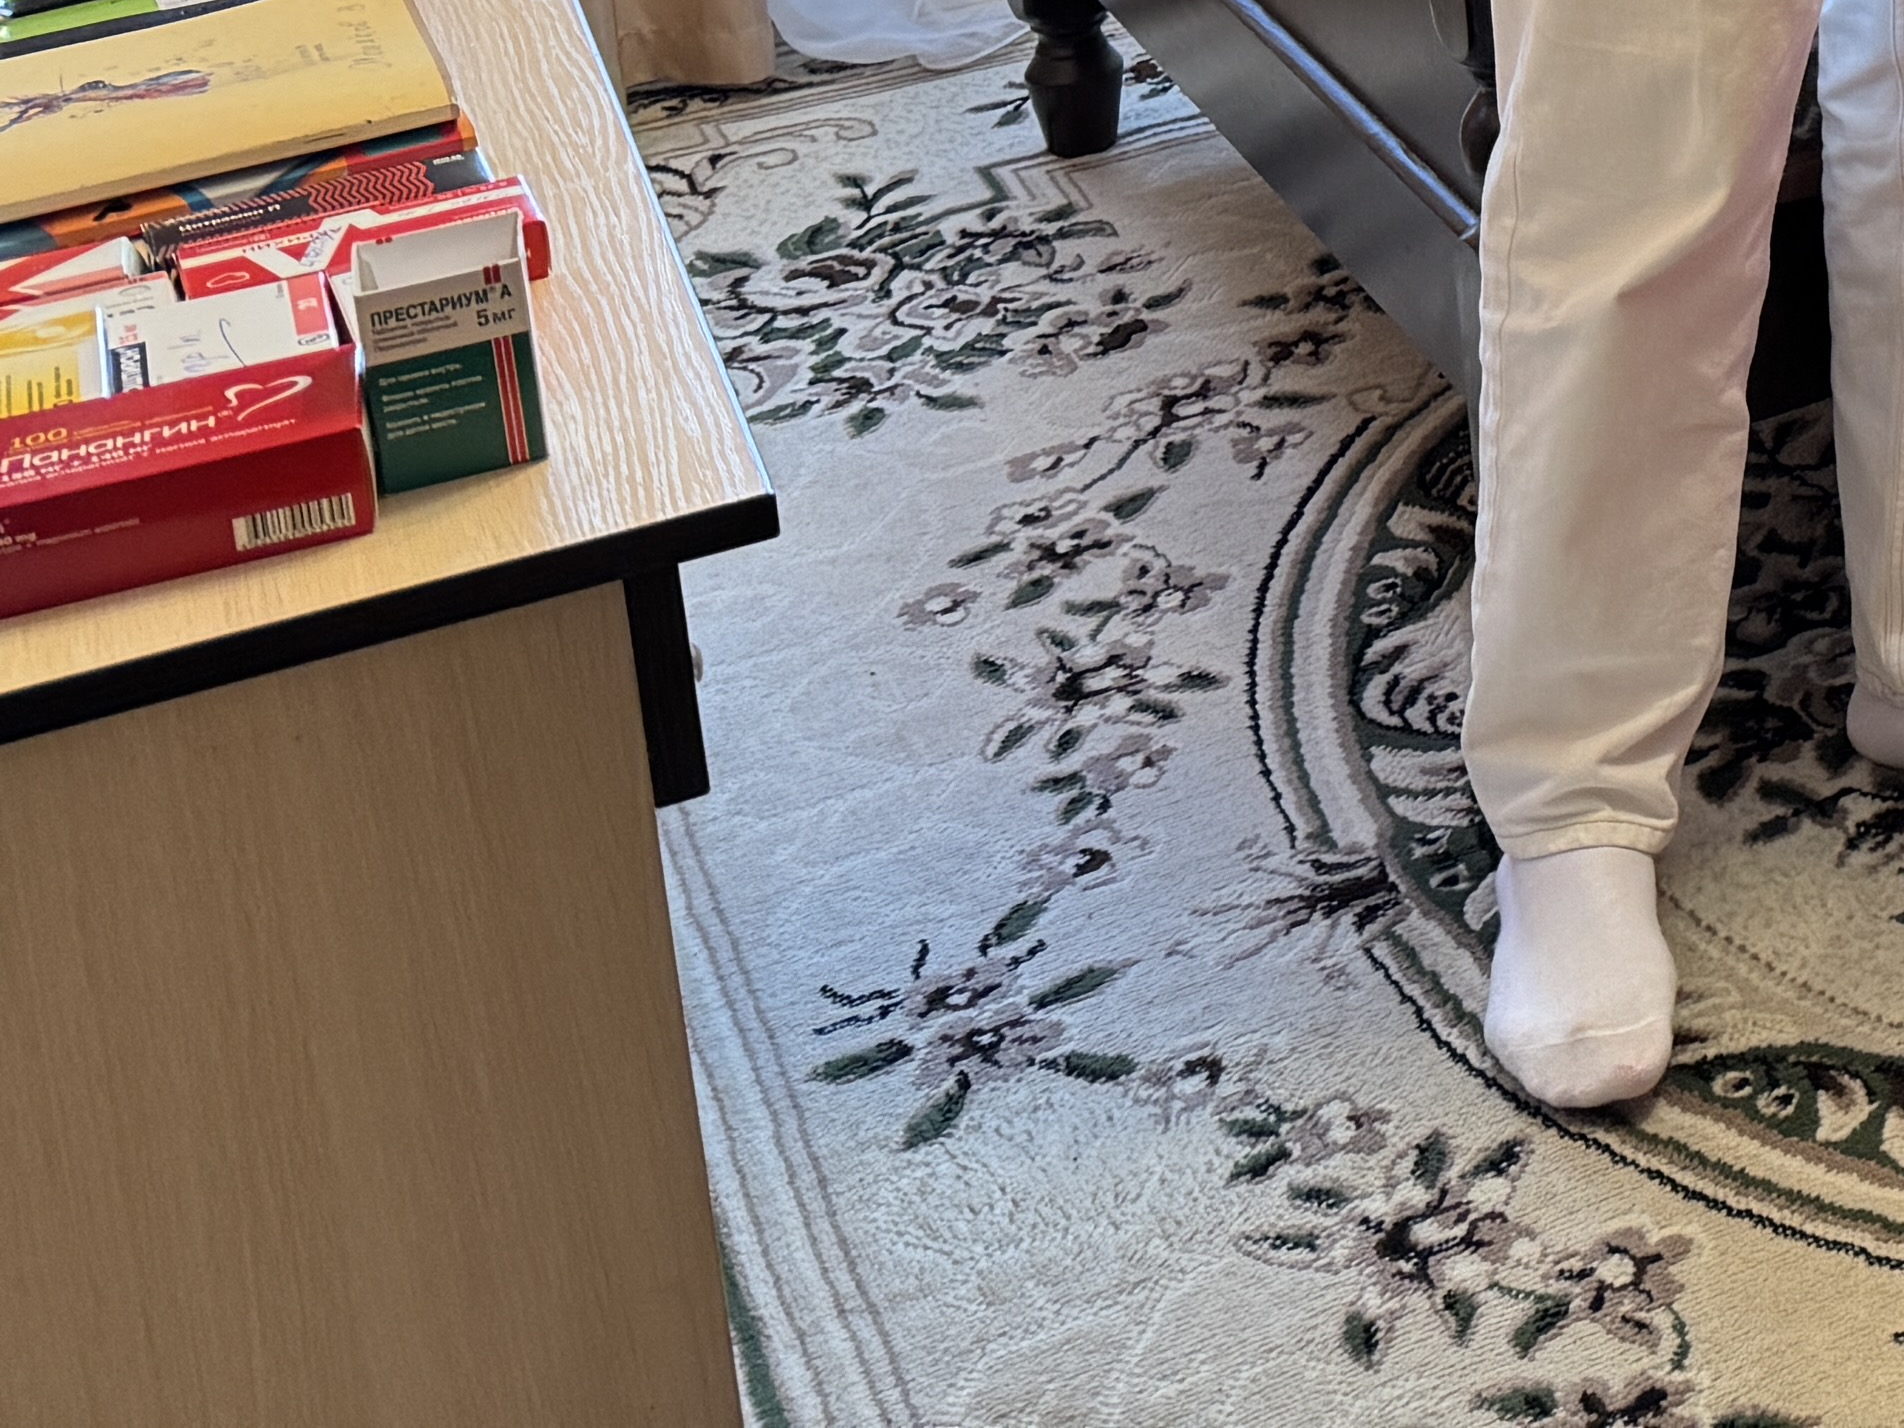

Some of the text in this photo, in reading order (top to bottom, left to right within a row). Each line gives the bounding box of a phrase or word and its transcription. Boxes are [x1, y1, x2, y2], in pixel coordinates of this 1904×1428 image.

[500, 283, 512, 299] А
[476, 307, 516, 327] 5 мг
[1, 415, 216, 471] Панангин
[10, 428, 68, 449] 100
